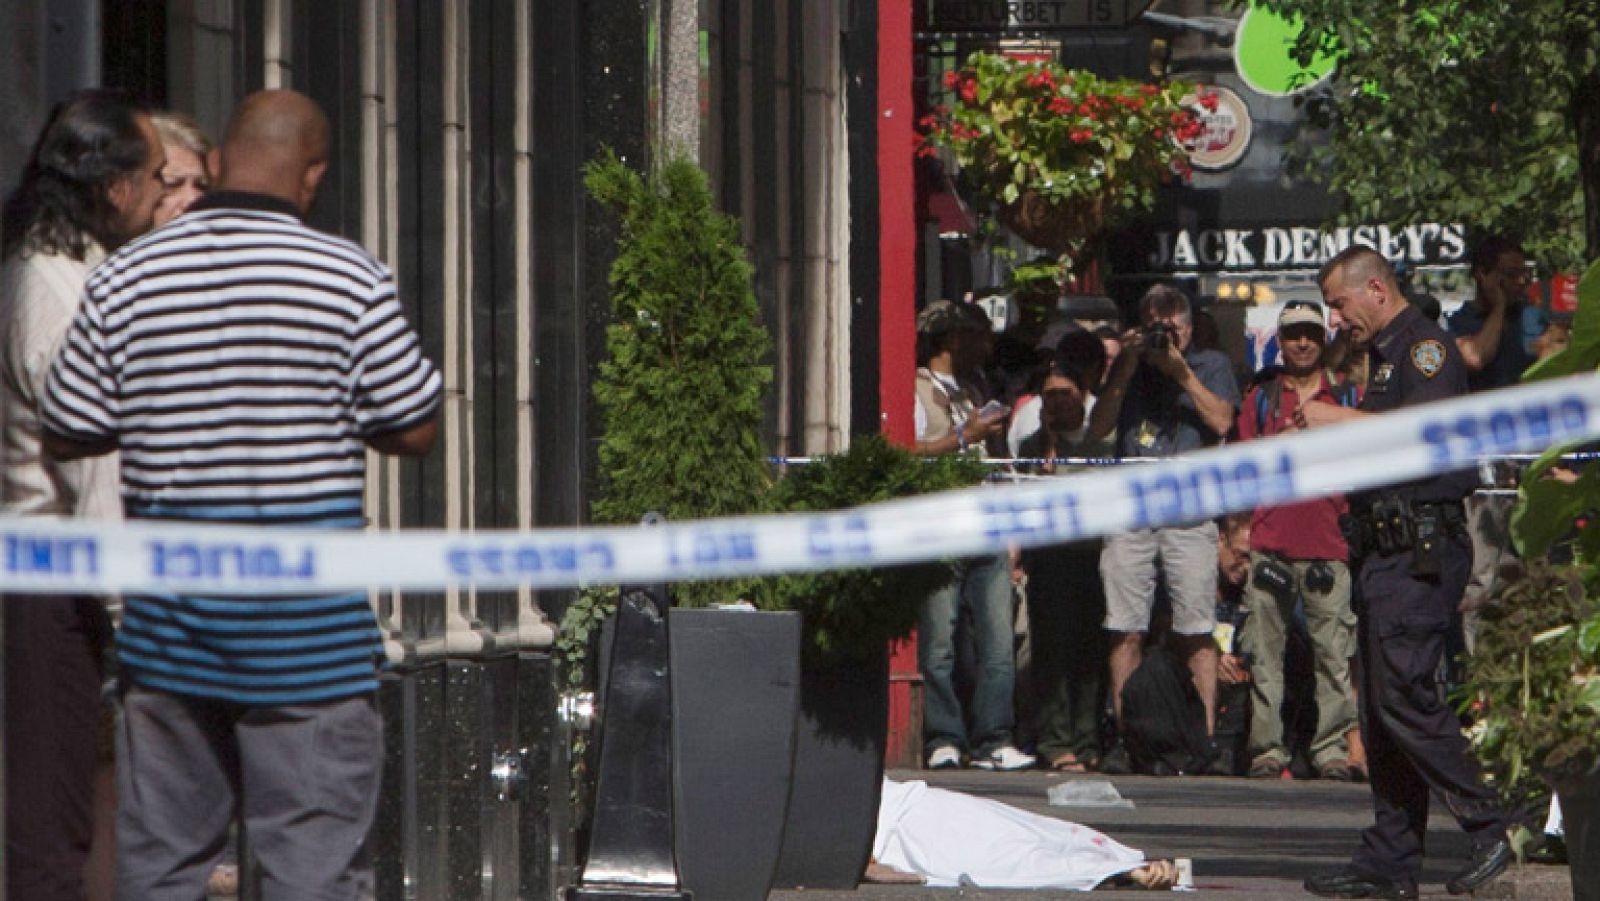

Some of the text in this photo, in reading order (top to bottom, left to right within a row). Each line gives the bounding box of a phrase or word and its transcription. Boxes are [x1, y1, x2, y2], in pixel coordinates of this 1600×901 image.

[1151, 229, 1255, 266] JACK
[1418, 393, 1590, 469] CROSS
[1128, 449, 1294, 526] POLICE
[149, 539, 315, 578] POLICE
[446, 540, 616, 577] CROSS
